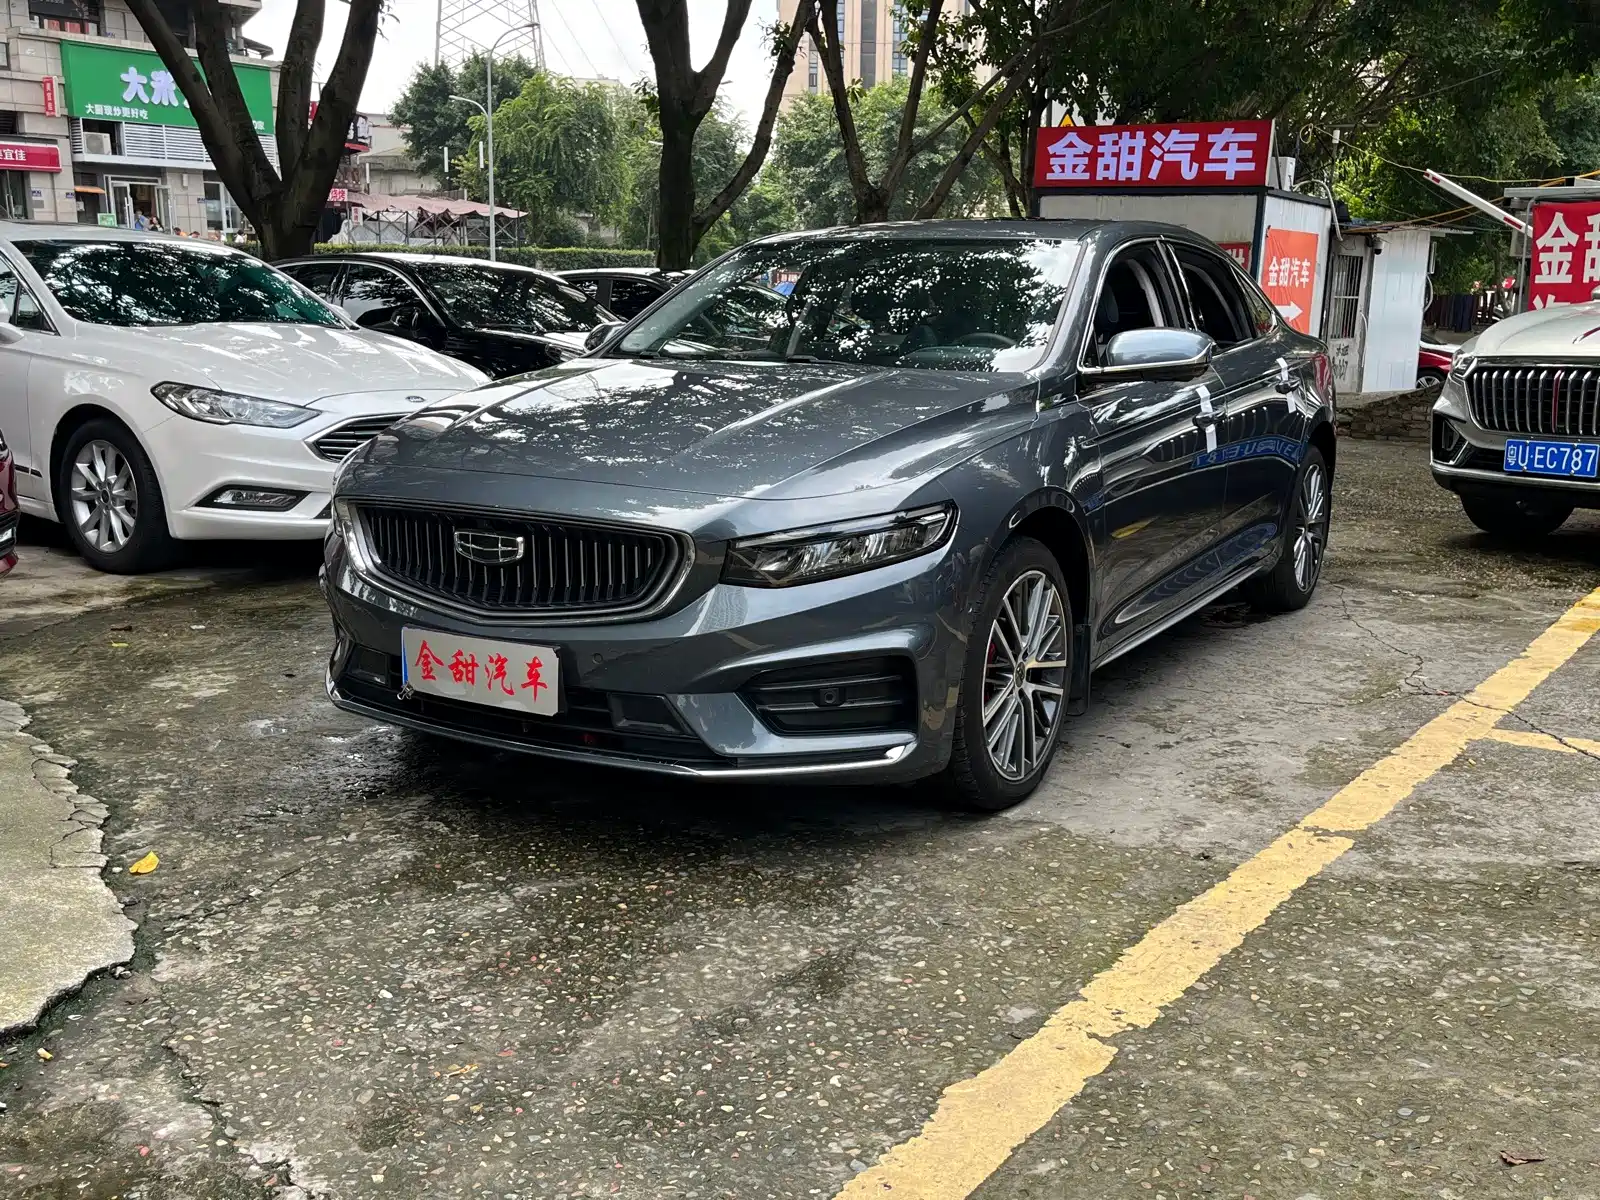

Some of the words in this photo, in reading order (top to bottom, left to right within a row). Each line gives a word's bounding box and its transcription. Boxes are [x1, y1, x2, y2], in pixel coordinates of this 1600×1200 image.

[1046, 128, 1257, 181] 金甜汽车
[1267, 256, 1311, 288] 金甜汽车
[414, 639, 548, 703] 金甜汽车
